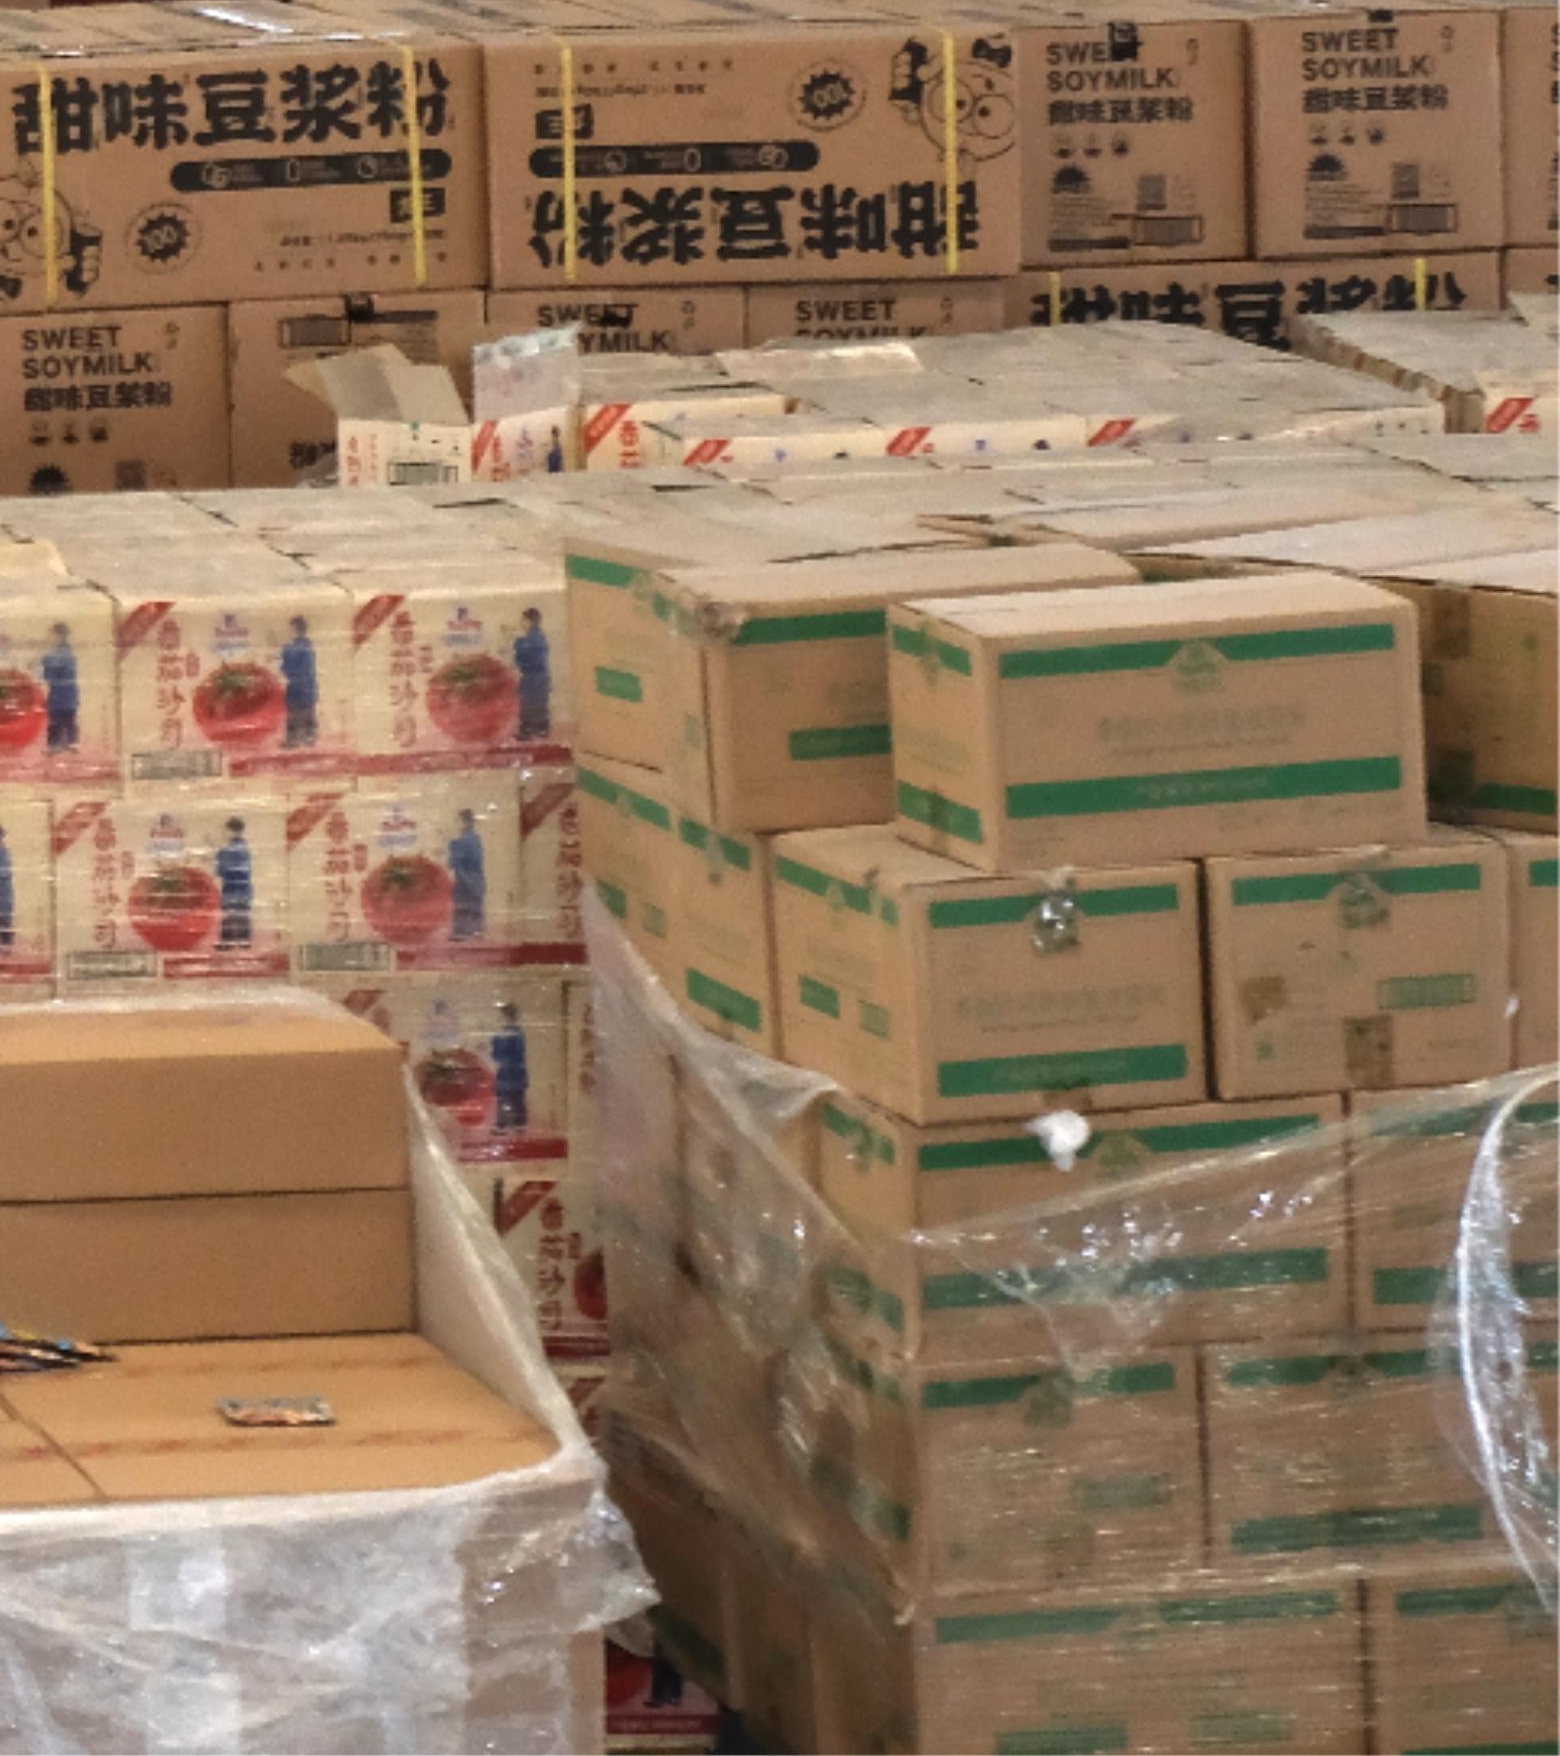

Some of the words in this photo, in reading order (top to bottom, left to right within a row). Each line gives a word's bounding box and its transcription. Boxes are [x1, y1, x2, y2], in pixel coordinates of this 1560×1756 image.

[1302, 28, 1399, 52] SWEET
[1047, 67, 1176, 92] SOYMILK
[1302, 57, 1431, 81] SOYMILK
[11, 60, 451, 158] 甜味豆浆粉
[1048, 97, 1193, 126] 甜味豆浆粉
[1303, 84, 1449, 113] 甜味豆浆粉
[527, 178, 979, 269] 甜味豆浆粉
[795, 298, 898, 323] SWEET
[21, 326, 122, 353] SWEET
[21, 353, 155, 380] SOYMILK
[23, 381, 172, 414] 甜味豆浆粉
